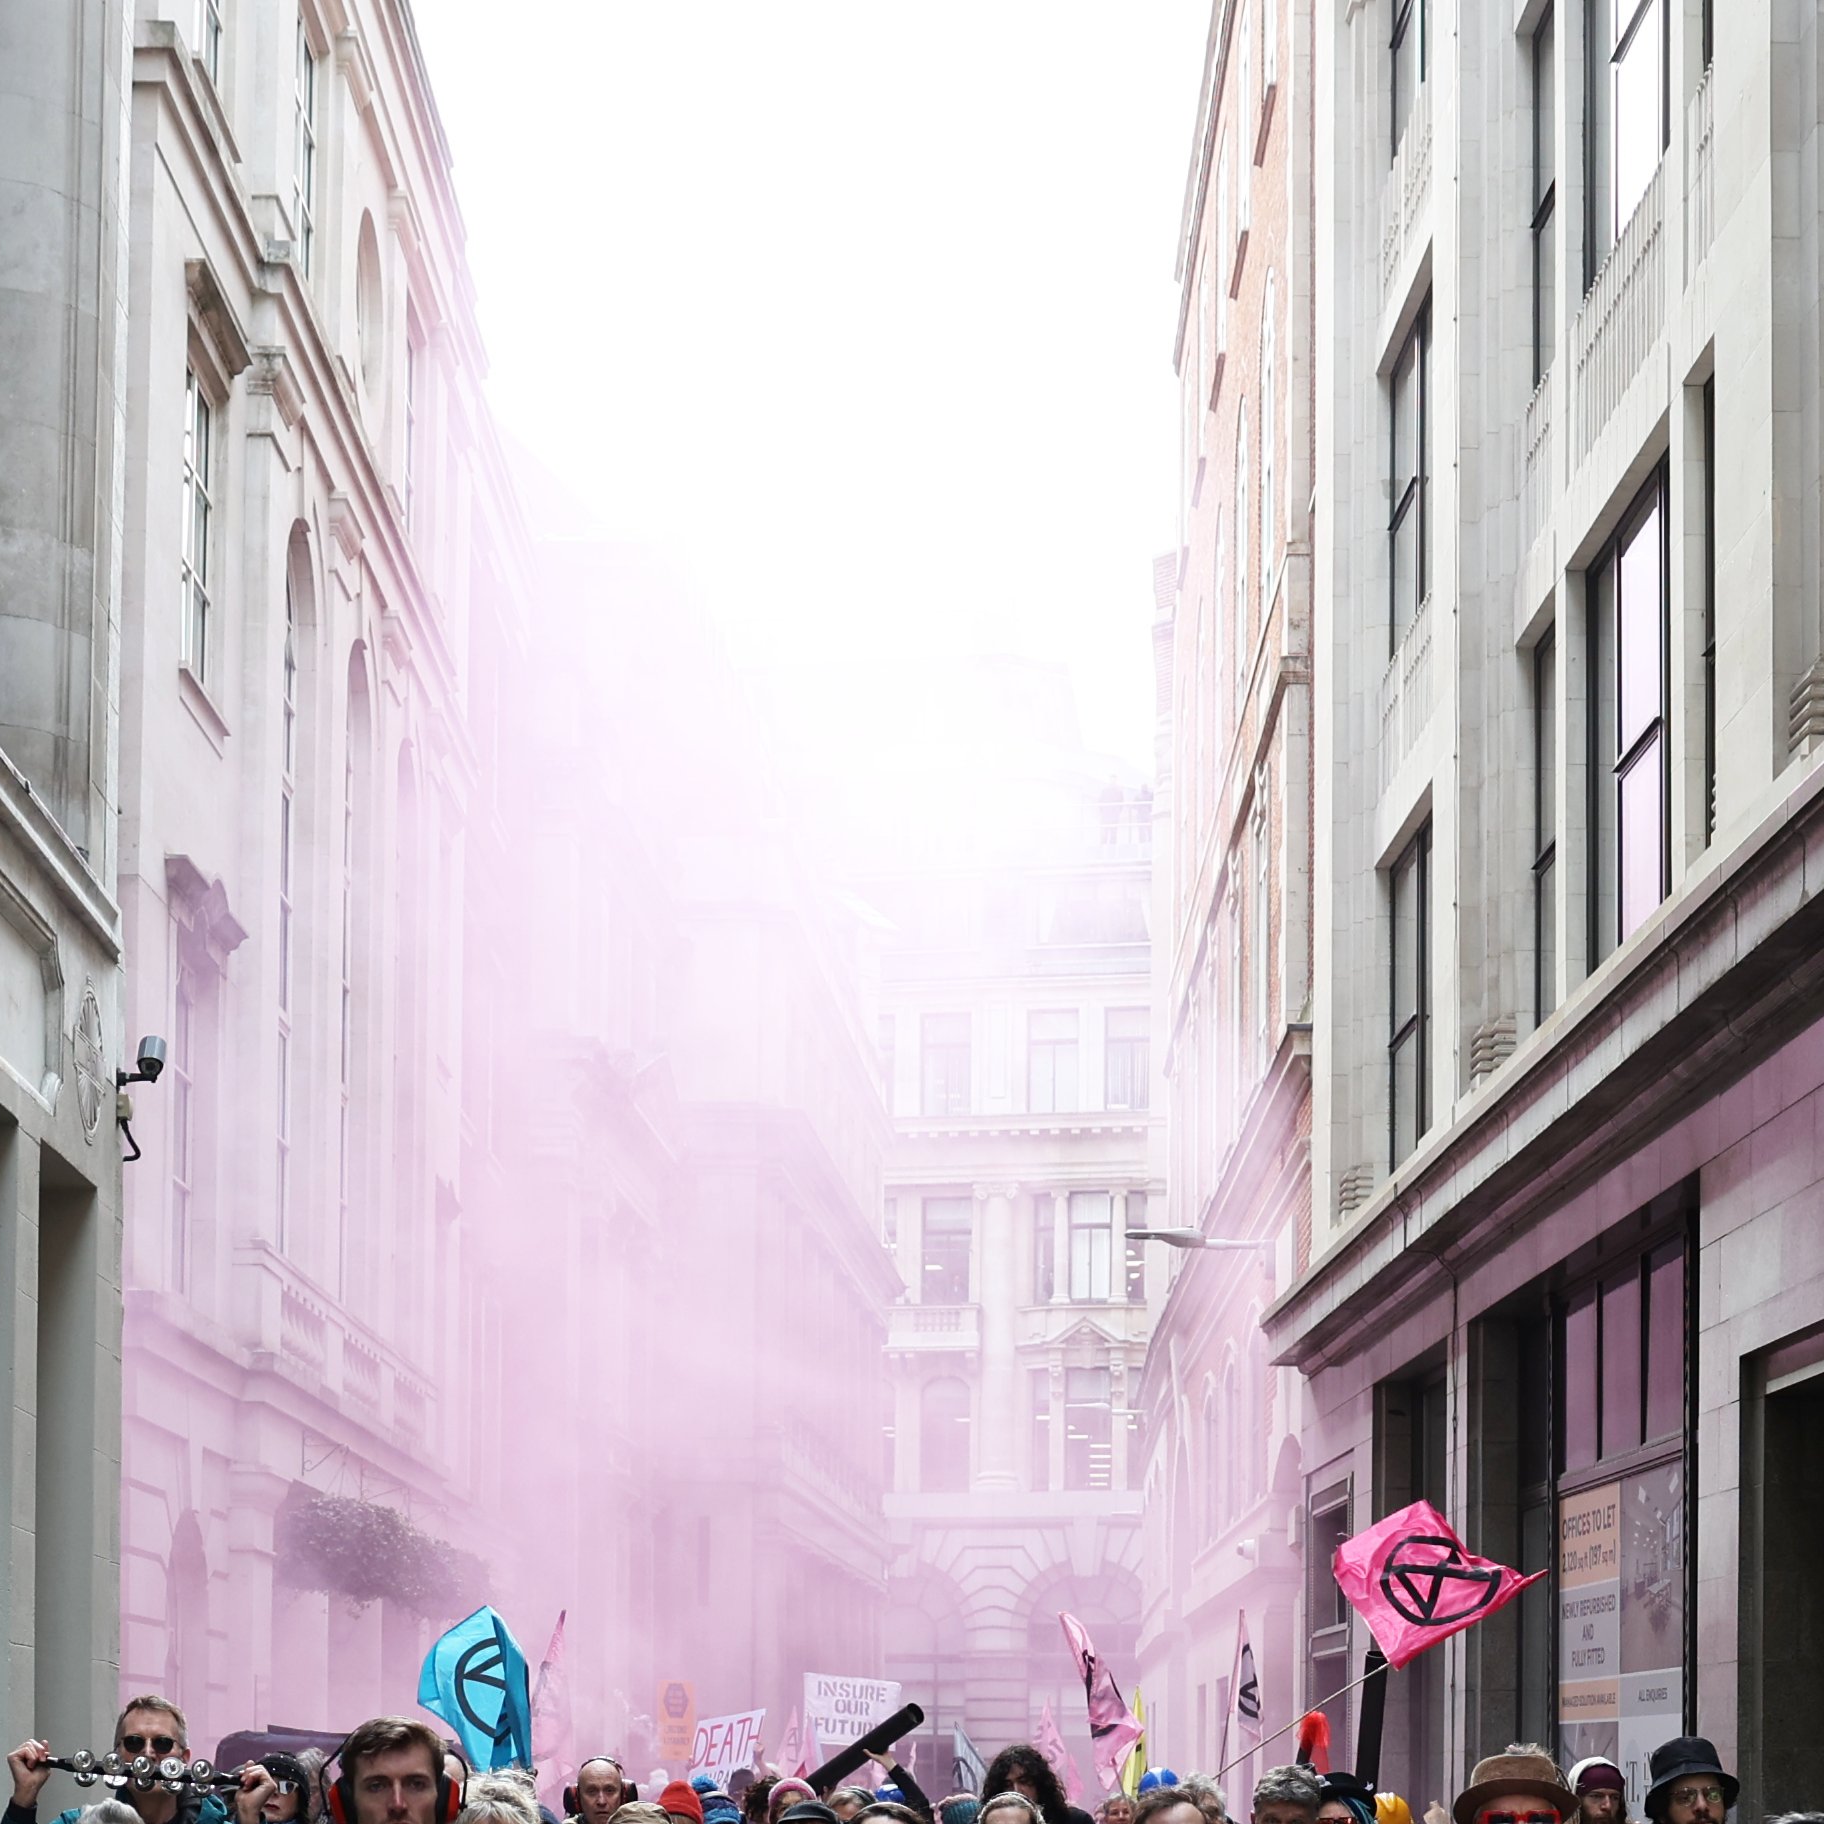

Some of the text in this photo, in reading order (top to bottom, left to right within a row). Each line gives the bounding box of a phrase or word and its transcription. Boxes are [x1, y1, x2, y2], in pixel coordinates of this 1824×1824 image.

[1562, 1504, 1616, 1540] OFFICES TO LET
[1582, 1623, 1594, 1641] AND
[817, 1680, 887, 1703] INSURE
[834, 1699, 870, 1716] OUR
[815, 1716, 877, 1737] FUTUR
[692, 1716, 764, 1768] DEATH
